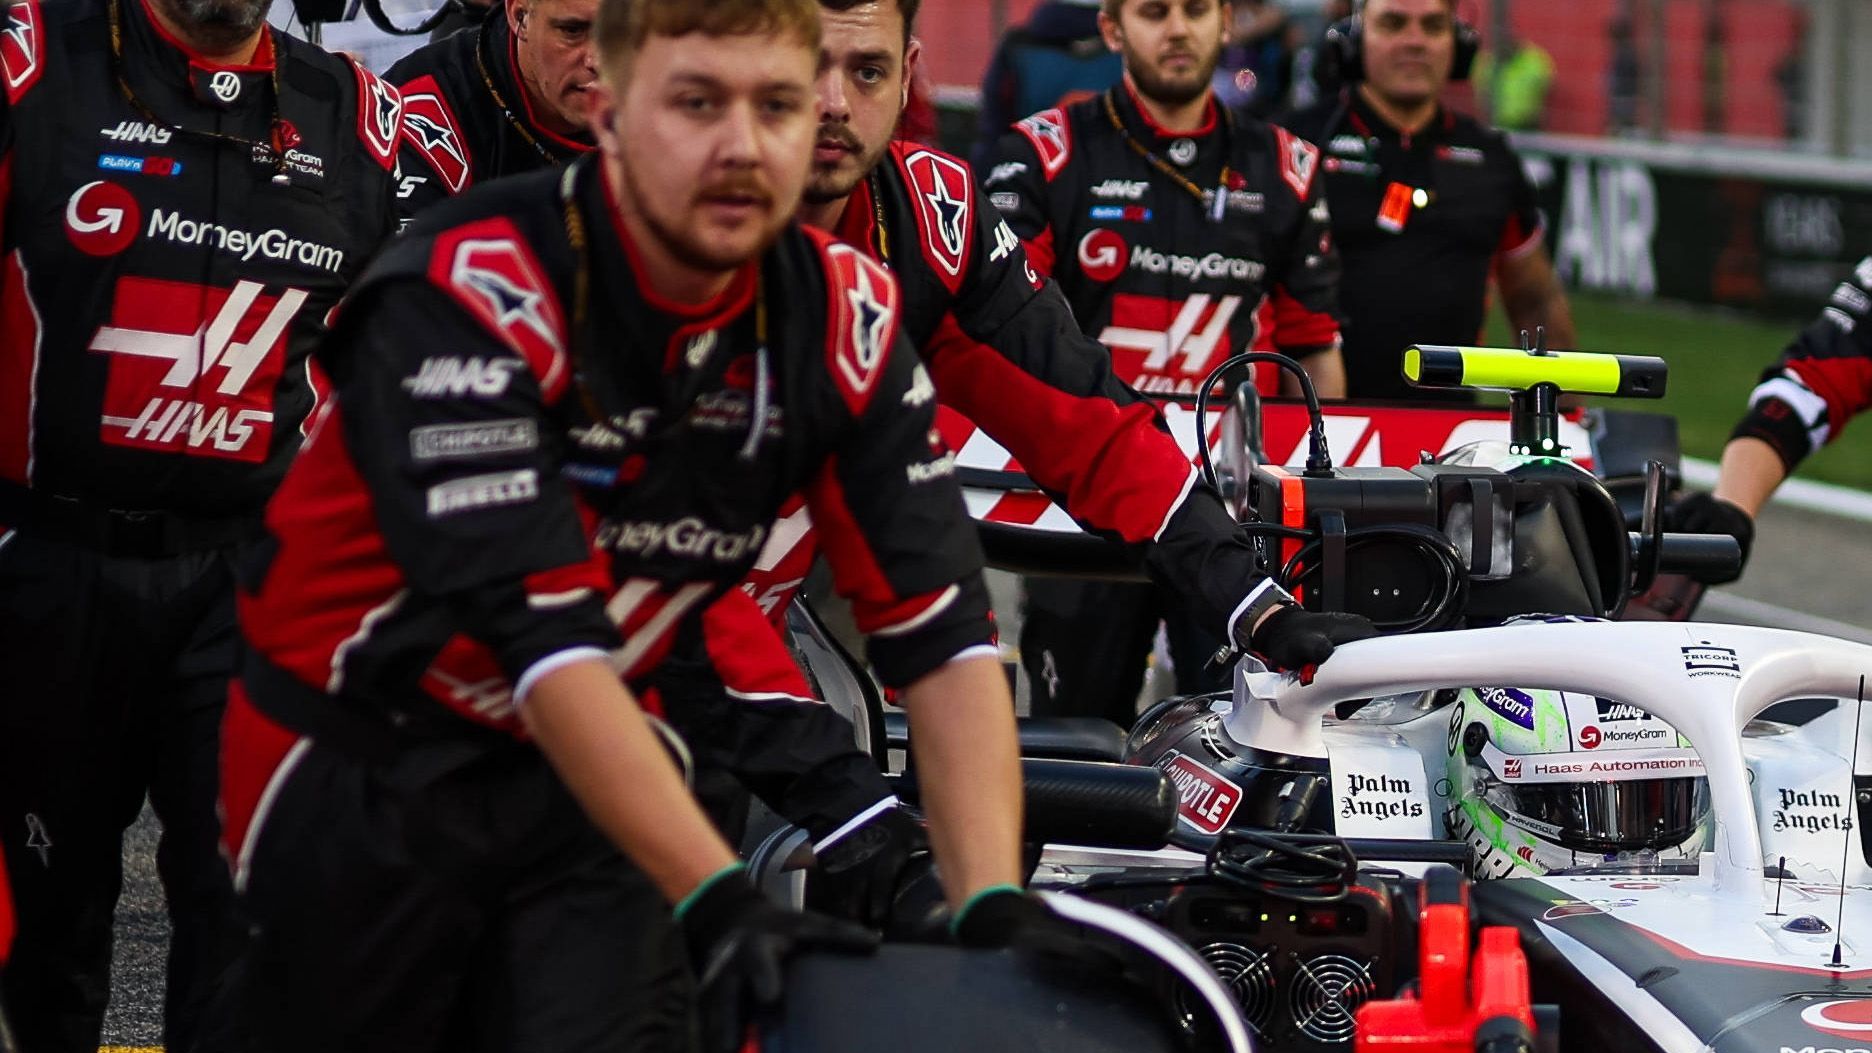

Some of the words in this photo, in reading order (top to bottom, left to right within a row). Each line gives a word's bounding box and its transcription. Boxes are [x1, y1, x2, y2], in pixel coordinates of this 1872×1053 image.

[101, 121, 182, 144] HAAS
[147, 208, 344, 272] MoneyGram
[1130, 245, 1266, 281] MoneyGram
[401, 356, 528, 395] HAAS
[101, 398, 273, 452] HAAS
[1683, 653, 1738, 662] TRICORP
[1603, 728, 1667, 745] MoneyGram
[1535, 762, 1583, 775] Haas
[1589, 758, 1686, 773] Automation
[1348, 773, 1412, 797] Palm
[1341, 797, 1423, 821] Angels
[1779, 788, 1841, 811] Palm
[1773, 810, 1853, 834] Angels
